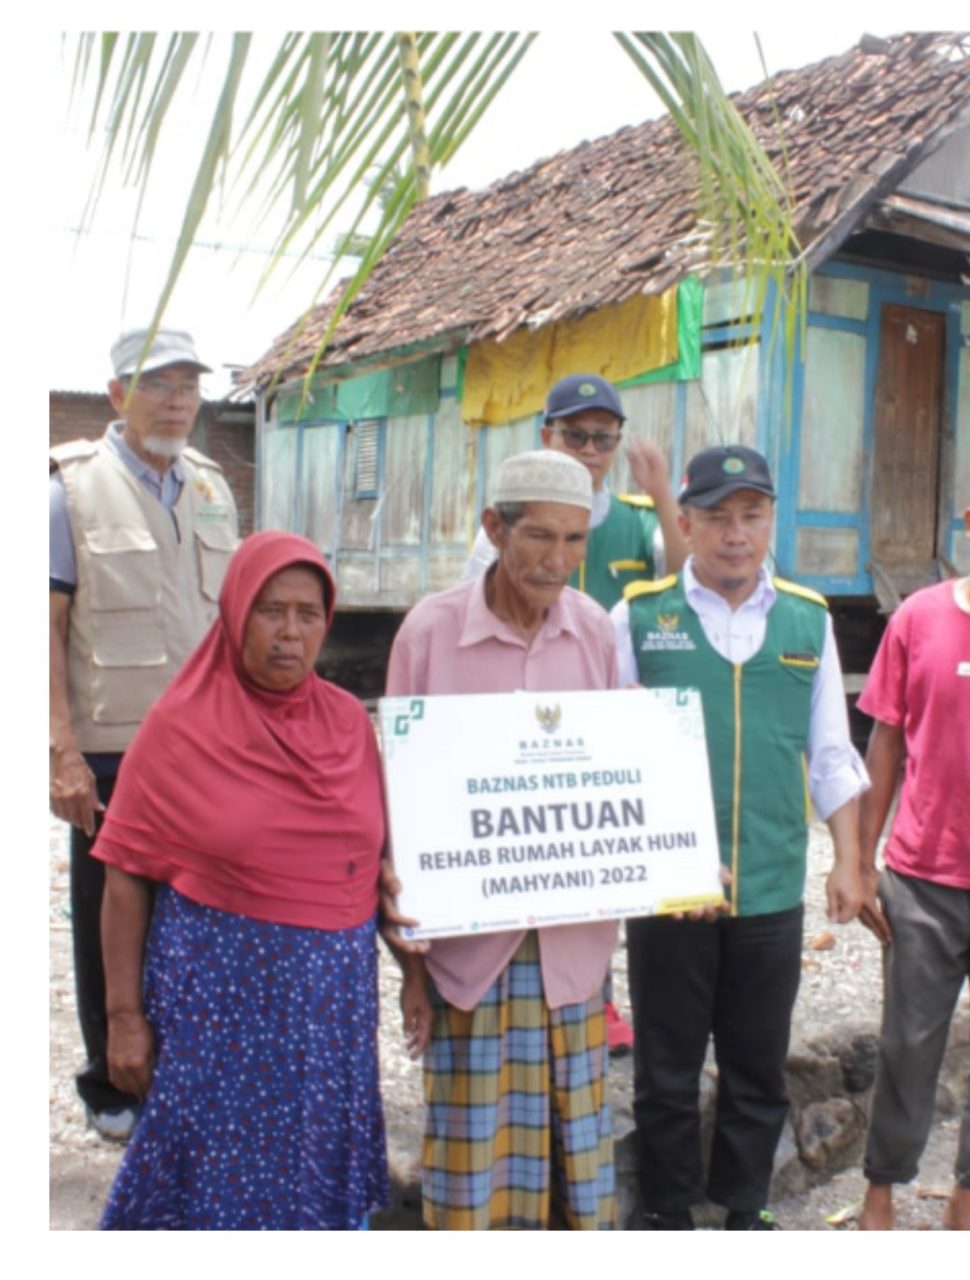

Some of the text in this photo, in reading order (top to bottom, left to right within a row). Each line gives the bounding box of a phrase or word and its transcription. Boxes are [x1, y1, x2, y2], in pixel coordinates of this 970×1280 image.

[466, 769, 642, 794] BAZNAS NTB PEDULI
[469, 797, 646, 839] BANTUAN
[419, 831, 697, 871] REHAB RUMAH LAYAK HUNI
[481, 864, 648, 898] (MAHYANI) 2022
